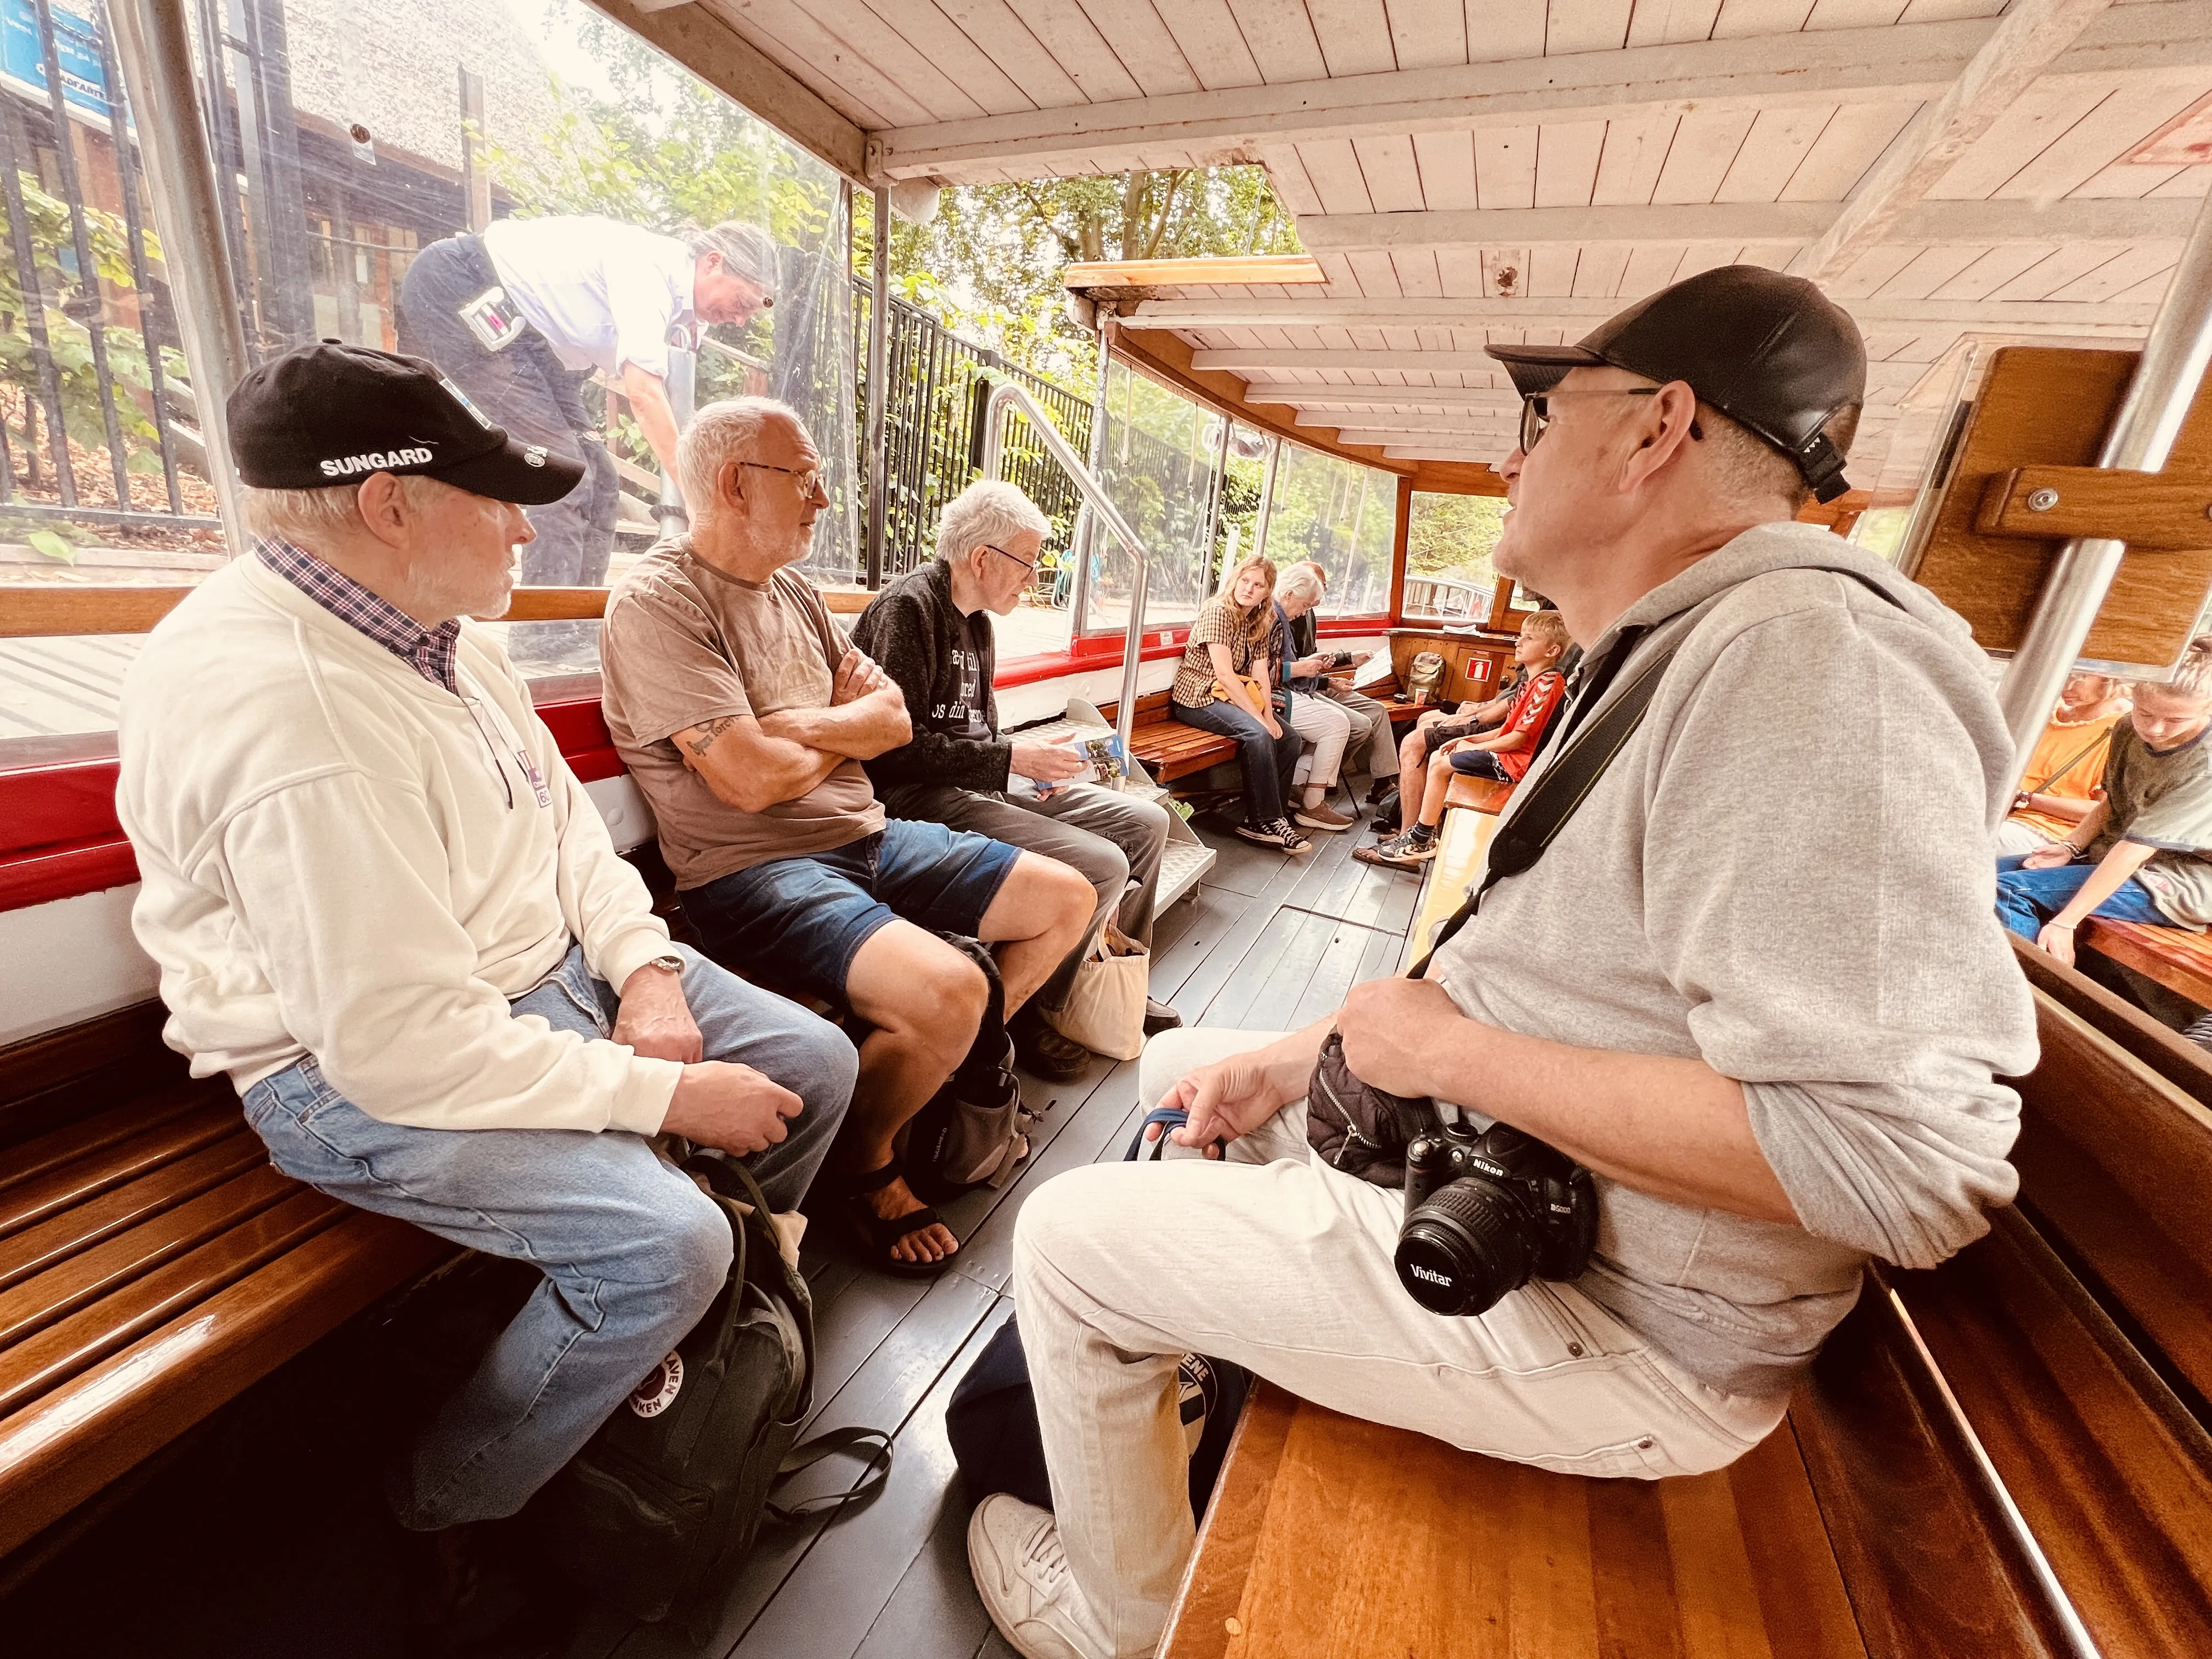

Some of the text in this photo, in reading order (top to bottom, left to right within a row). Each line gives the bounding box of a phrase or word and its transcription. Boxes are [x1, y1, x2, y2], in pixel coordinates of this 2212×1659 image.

[320, 448, 433, 476] SUNGARD
[949, 701, 965, 719] din
[1473, 1159, 1504, 1177] Nikon
[1410, 1263, 1452, 1287] Vivitar
[1181, 1353, 1209, 1381] ENE
